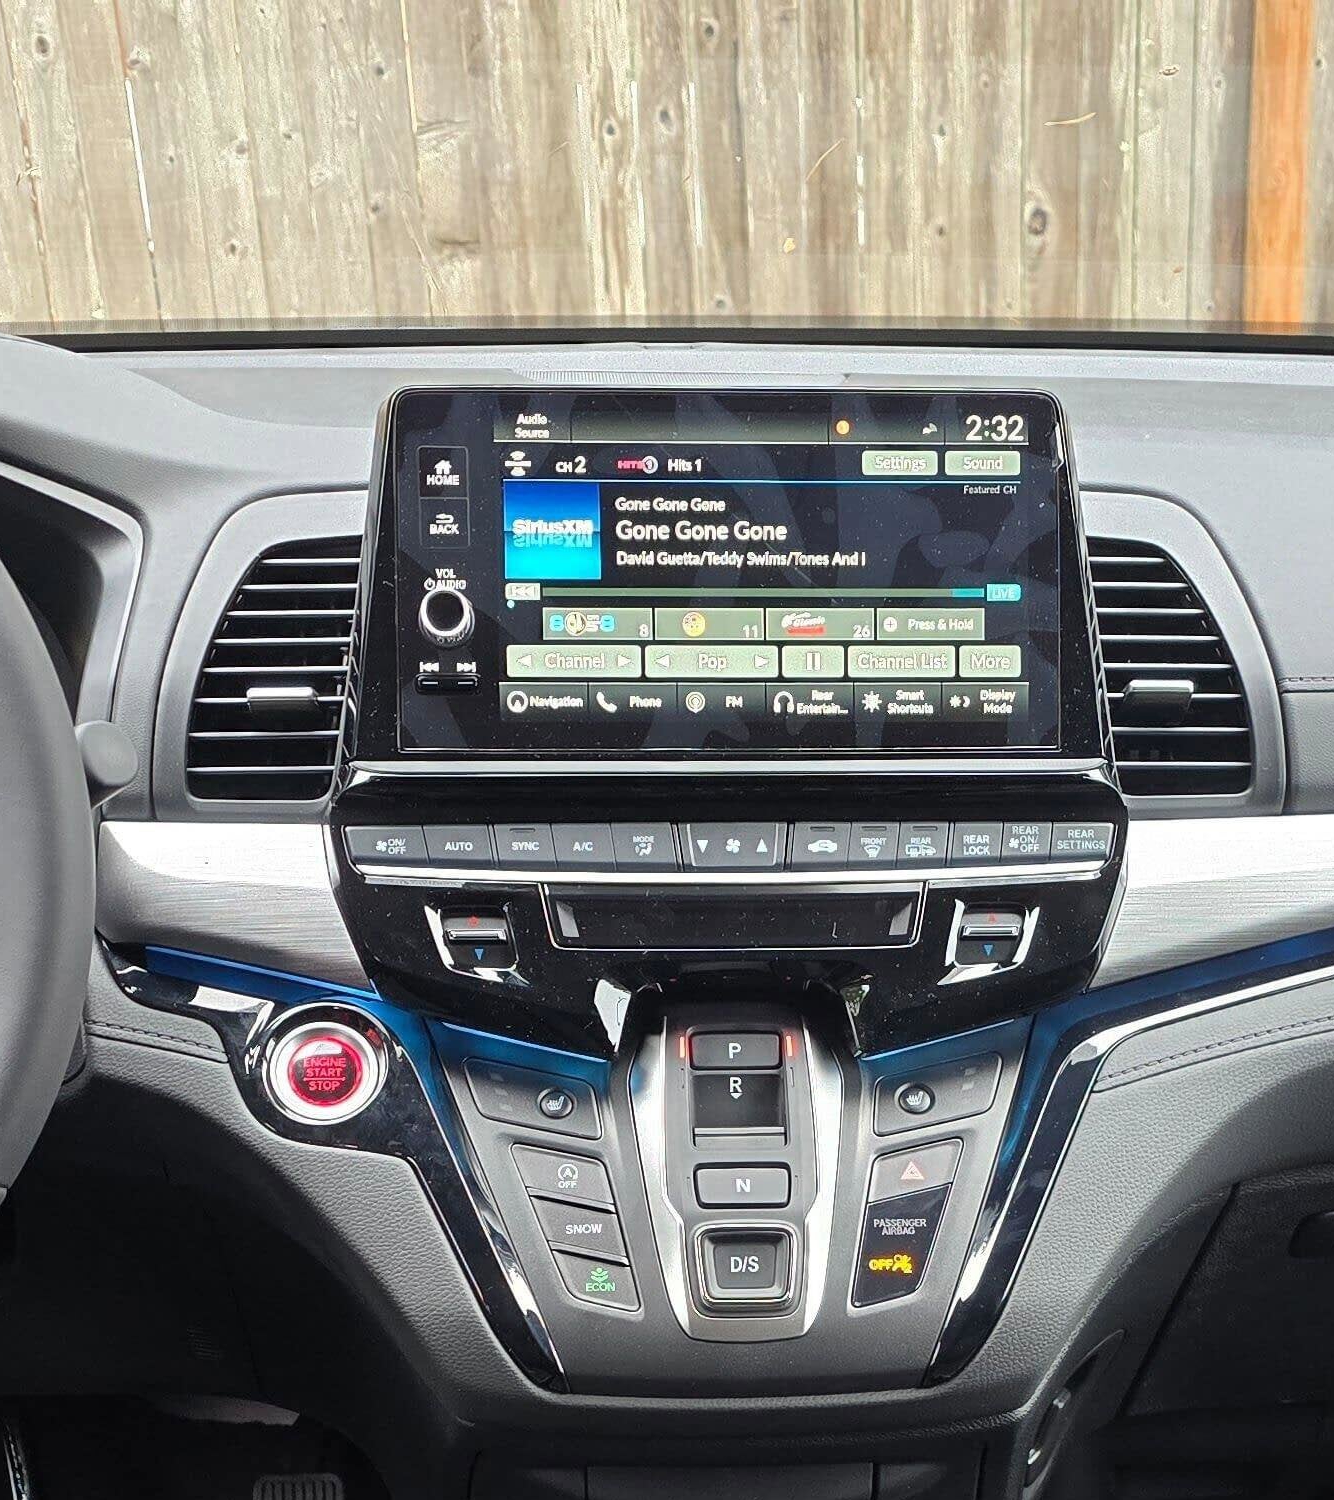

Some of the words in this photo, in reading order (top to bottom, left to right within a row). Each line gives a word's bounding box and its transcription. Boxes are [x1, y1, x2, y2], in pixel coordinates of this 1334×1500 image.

[516, 413, 548, 425] Audio
[965, 415, 1025, 441] 2:32
[555, 461, 572, 473] CH
[573, 455, 587, 474] 2
[667, 458, 693, 472] Hits
[694, 458, 702, 472] 1
[874, 455, 927, 471] Settings
[962, 455, 1004, 470] Sound
[426, 474, 460, 486] HOME
[963, 485, 1001, 494] Featured
[1002, 485, 1017, 495] CH
[615, 497, 650, 512] Gone
[652, 497, 688, 512] Gone
[690, 497, 726, 512] Gone
[429, 523, 460, 535] BACK
[512, 519, 594, 535] SiriusXM
[616, 520, 670, 541] Gone
[674, 520, 729, 541] Gone
[733, 520, 788, 541] Gone
[616, 551, 654, 566] David
[656, 551, 744, 569] Guetta/Teddy
[746, 551, 829, 568] Swims/Tones
[831, 551, 858, 566] And
[435, 568, 457, 579] VOL
[435, 579, 467, 590] AUDIO
[992, 588, 1016, 598] LIVE
[639, 623, 650, 638] 8
[853, 623, 871, 638] 26
[907, 619, 935, 631] Press
[937, 619, 947, 631] &
[949, 619, 974, 631] Hold
[742, 625, 759, 638] 11
[544, 652, 605, 670] Channel
[697, 654, 728, 672] Pop
[857, 653, 916, 671] Channel
[920, 653, 948, 671] List
[969, 653, 1011, 670] More
[811, 690, 834, 701] Rear
[895, 689, 925, 701] Smart
[979, 689, 1016, 702] Display
[529, 695, 584, 710] Navigation
[629, 695, 662, 708] Phone
[725, 695, 743, 708] FM
[886, 703, 934, 714] Shortcuts
[983, 703, 1013, 714] Mode
[1012, 826, 1039, 836] REAR
[1067, 829, 1095, 839] REAR
[387, 838, 406, 847] ON/
[632, 835, 655, 844] MODE
[860, 837, 887, 846] FRONT
[910, 837, 931, 845] REAR
[963, 835, 990, 846] REAR
[1019, 835, 1039, 845] ON/
[1056, 839, 1106, 850] SETTINGS
[387, 846, 407, 855] OFF
[444, 841, 473, 852] AUTO
[511, 841, 540, 852] SYNC
[573, 841, 594, 852] A/C
[963, 845, 991, 856] LOCK
[1019, 843, 1039, 853] OFF
[728, 1042, 742, 1059] P
[303, 1057, 347, 1068] ENGINE
[305, 1068, 343, 1077] START
[308, 1081, 341, 1090] STOP
[729, 1077, 742, 1093] R
[557, 1181, 578, 1189] OFF
[735, 1178, 751, 1193] N
[873, 1218, 927, 1227] PASSENGER
[565, 1223, 603, 1235] SNOW
[881, 1227, 916, 1236] AIRBAG
[730, 1255, 760, 1273] D/S
[868, 1258, 894, 1270] OFF
[585, 1282, 616, 1292] ECON
